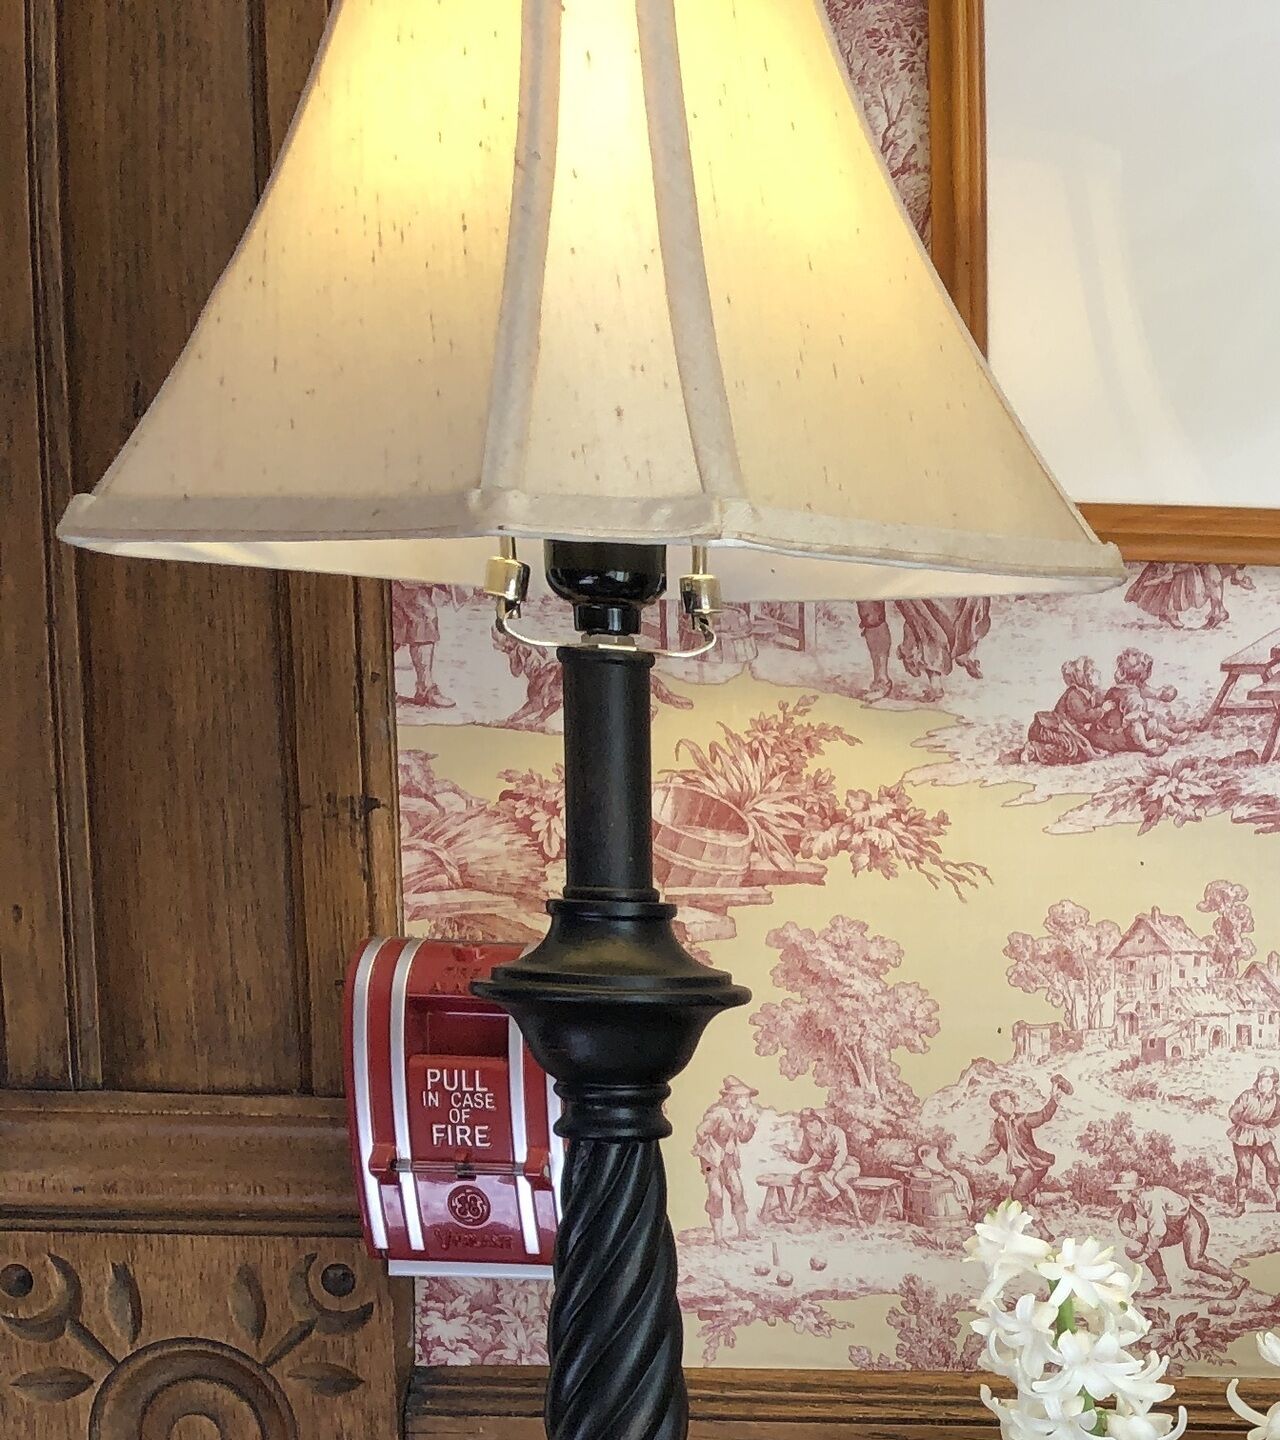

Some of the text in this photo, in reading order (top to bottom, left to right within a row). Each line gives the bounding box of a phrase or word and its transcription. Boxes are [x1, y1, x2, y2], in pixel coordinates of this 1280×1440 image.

[427, 1069, 489, 1092] PULL
[423, 1092, 495, 1109] IN CASE
[449, 1109, 470, 1123] OF
[432, 1125, 492, 1148] FIRE
